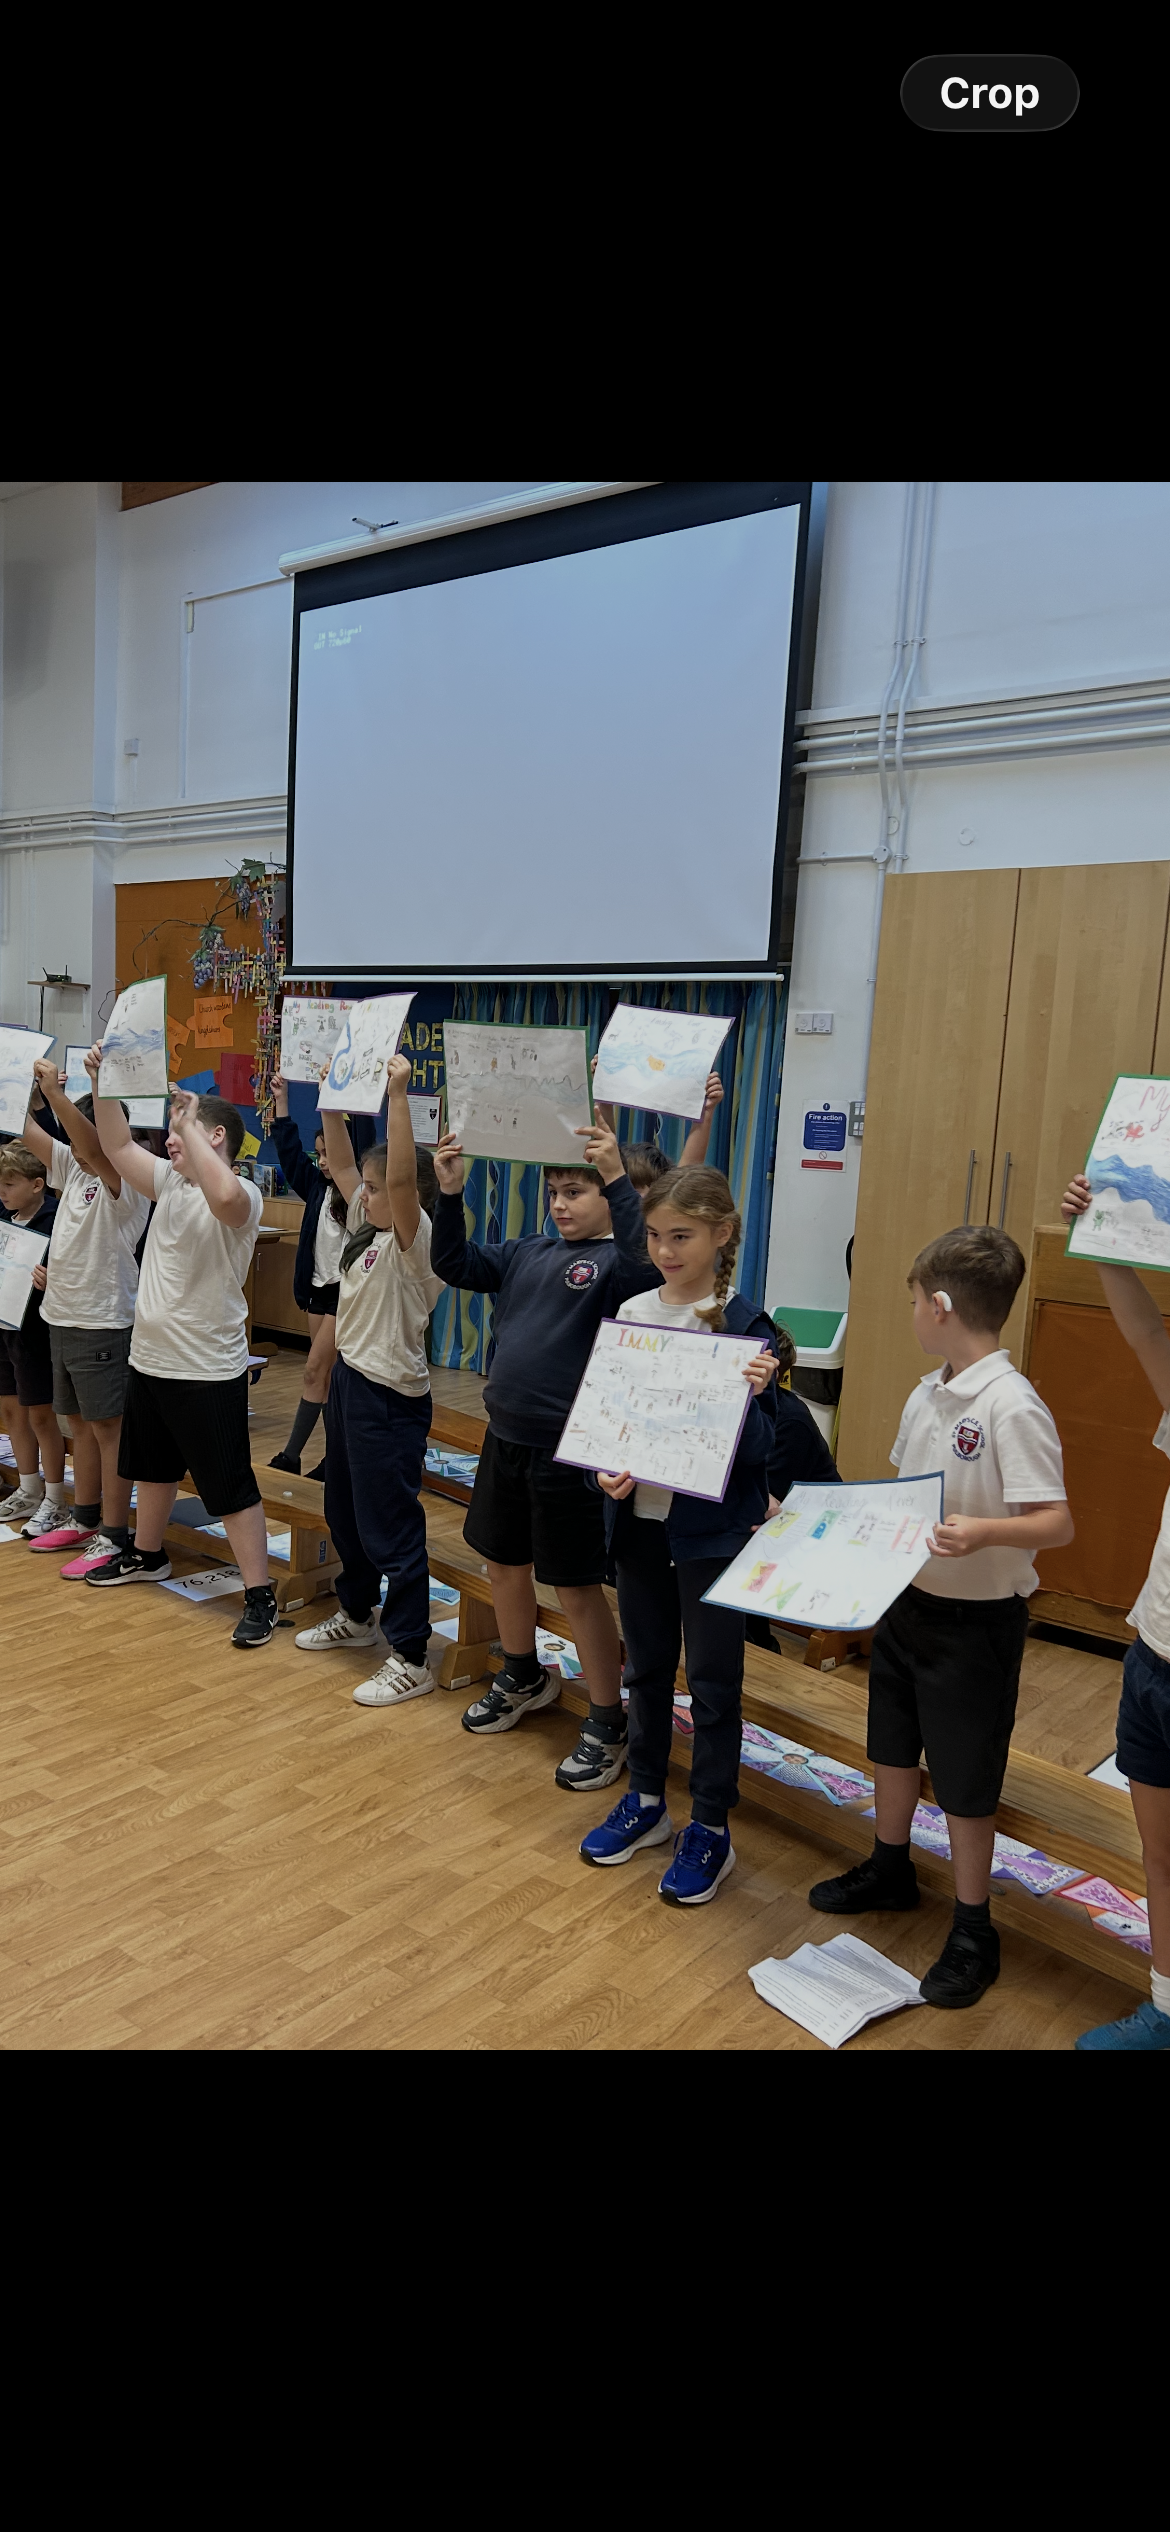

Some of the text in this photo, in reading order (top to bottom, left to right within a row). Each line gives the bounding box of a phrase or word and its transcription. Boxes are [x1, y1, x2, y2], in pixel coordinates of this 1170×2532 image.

[329, 631, 336, 639] No
[340, 625, 361, 637] Signal
[292, 1000, 301, 1014] My
[307, 999, 335, 1013] Reading
[399, 1022, 444, 1052] ADE
[412, 1058, 445, 1089] HT
[808, 1113, 822, 1121] Fire
